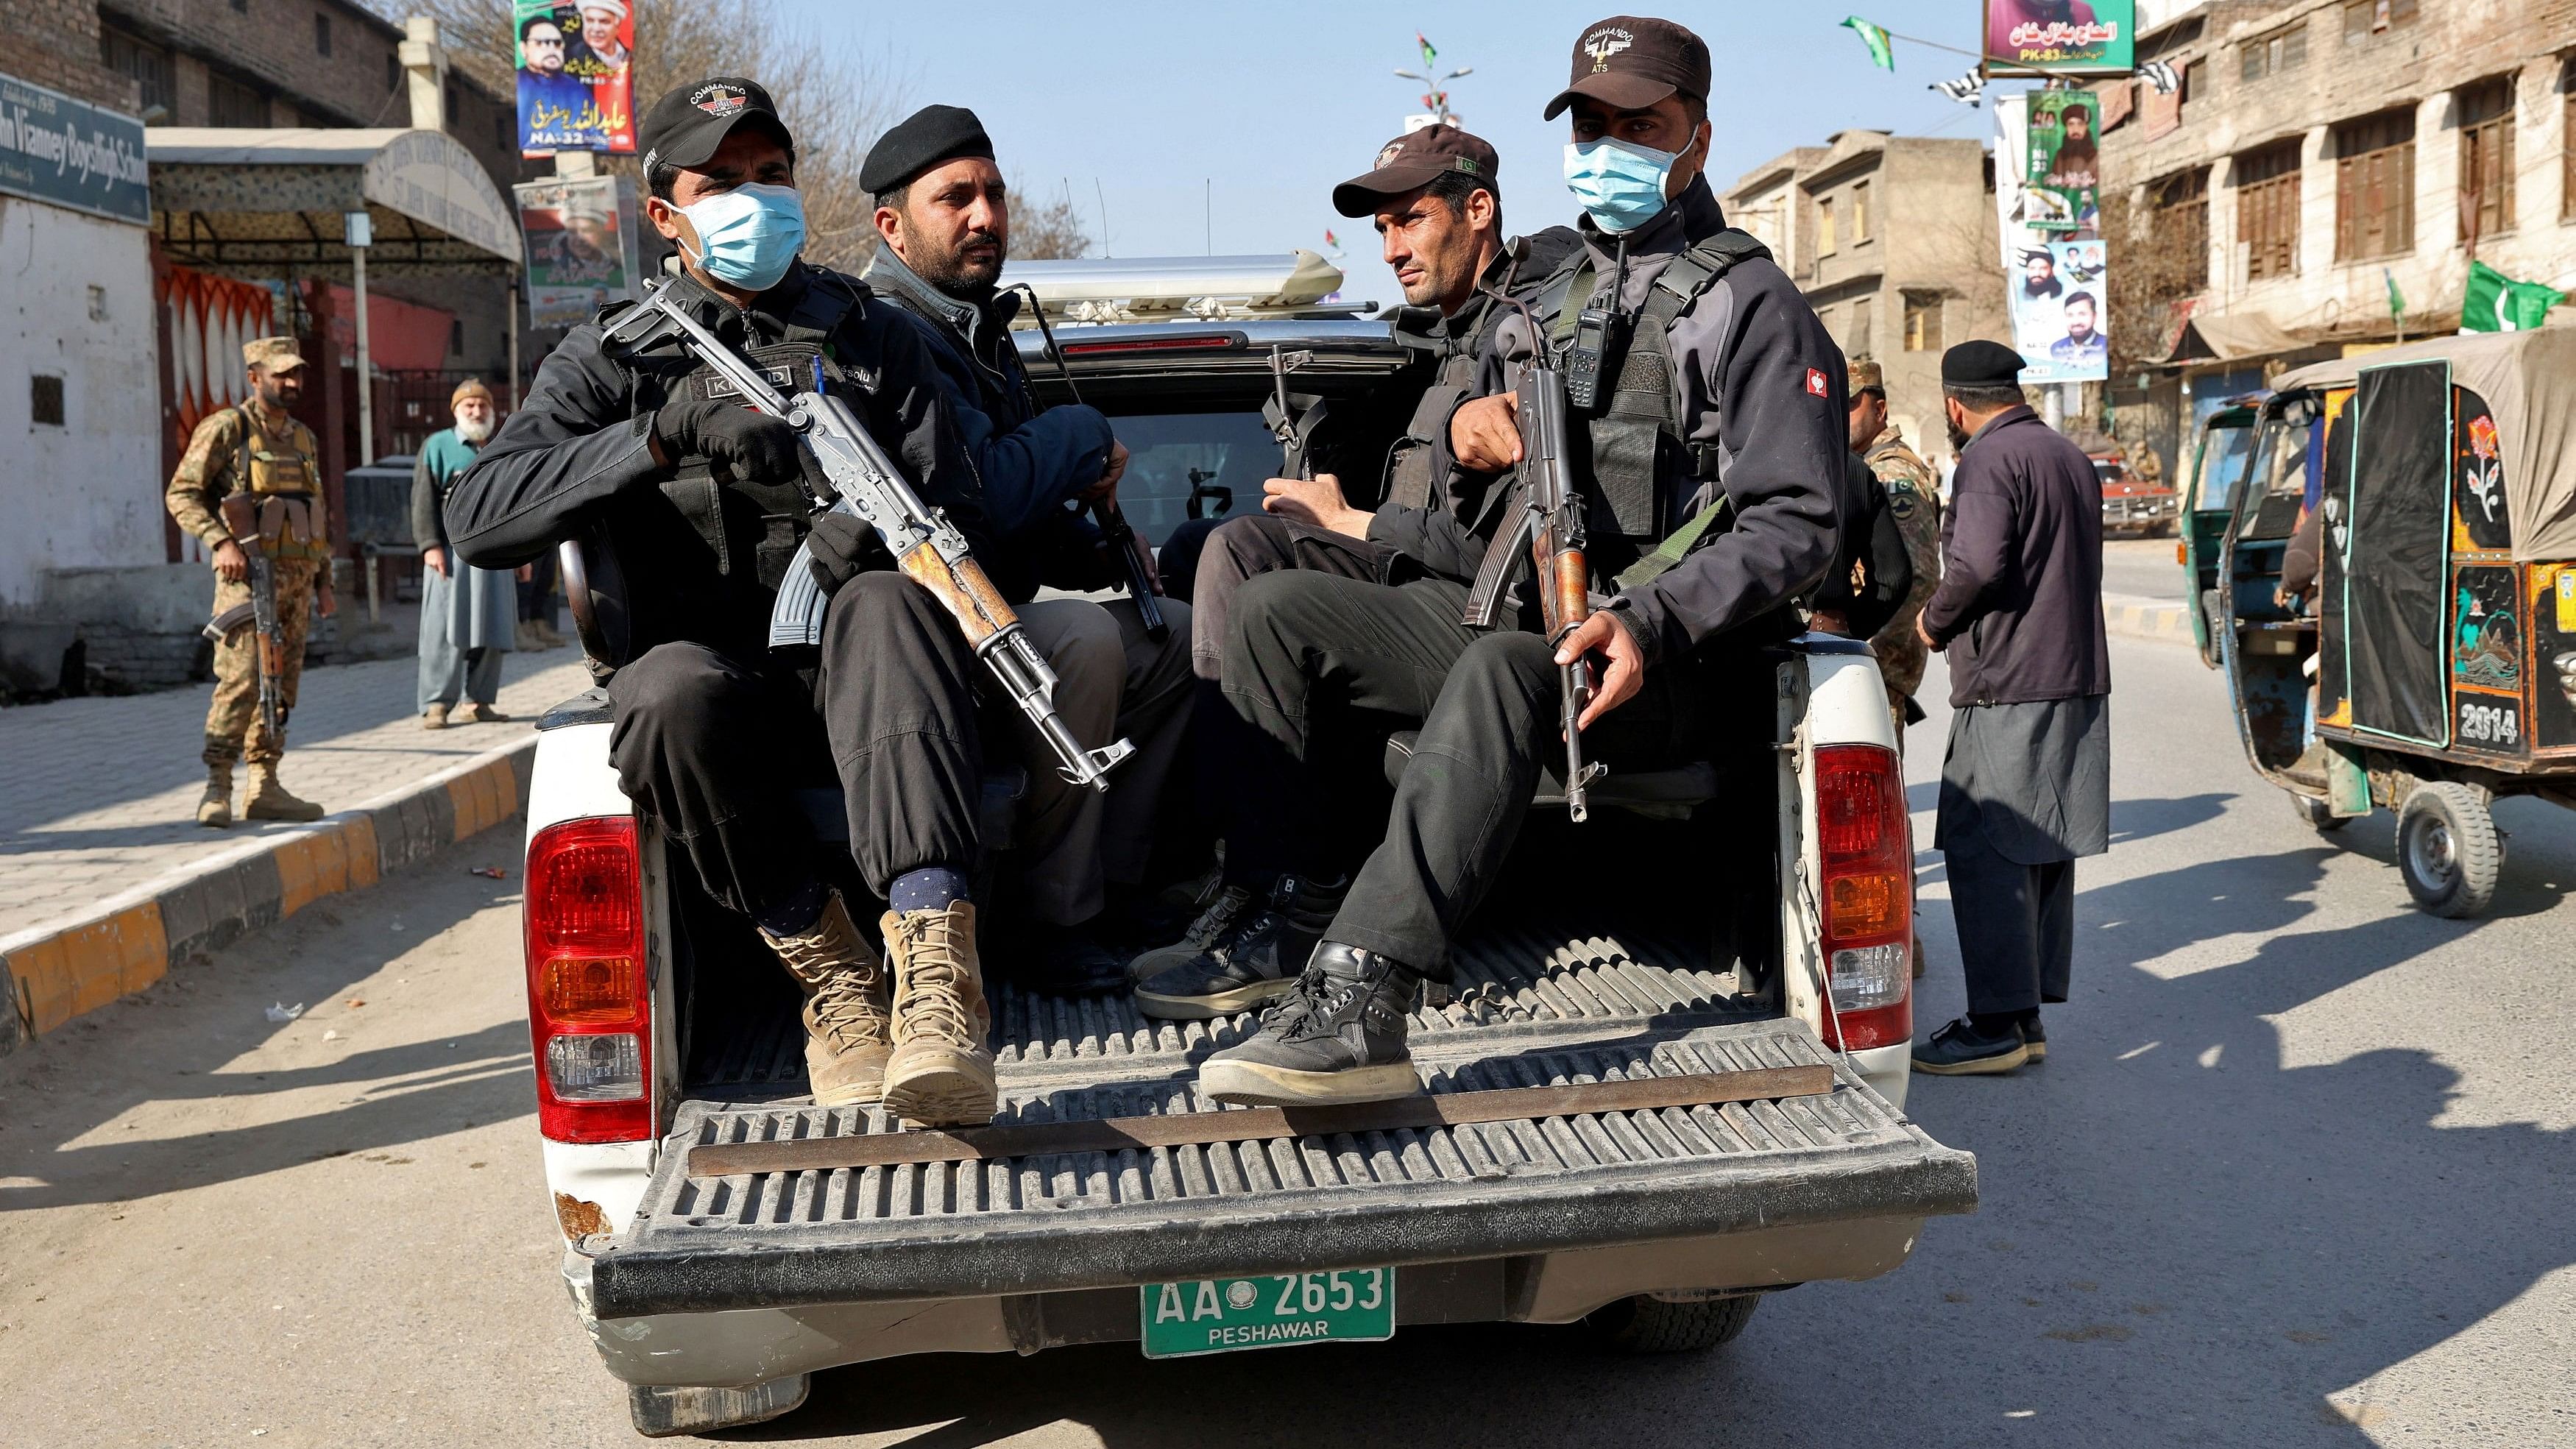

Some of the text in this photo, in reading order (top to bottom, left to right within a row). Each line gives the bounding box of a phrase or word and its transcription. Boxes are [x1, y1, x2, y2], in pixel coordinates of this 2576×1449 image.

[1585, 26, 1634, 46] COMMANDO
[2009, 21, 2042, 46] خان
[2076, 21, 2117, 46] الحاج
[2020, 48, 2060, 61] PK-83
[1591, 63, 1608, 74] ATS
[690, 83, 746, 104] COMMANDO
[530, 131, 584, 145] NA-32
[2460, 704, 2517, 745] 2014
[1156, 1268, 1383, 1324] AA 2653
[1209, 1320, 1329, 1345] PESHAWAR
